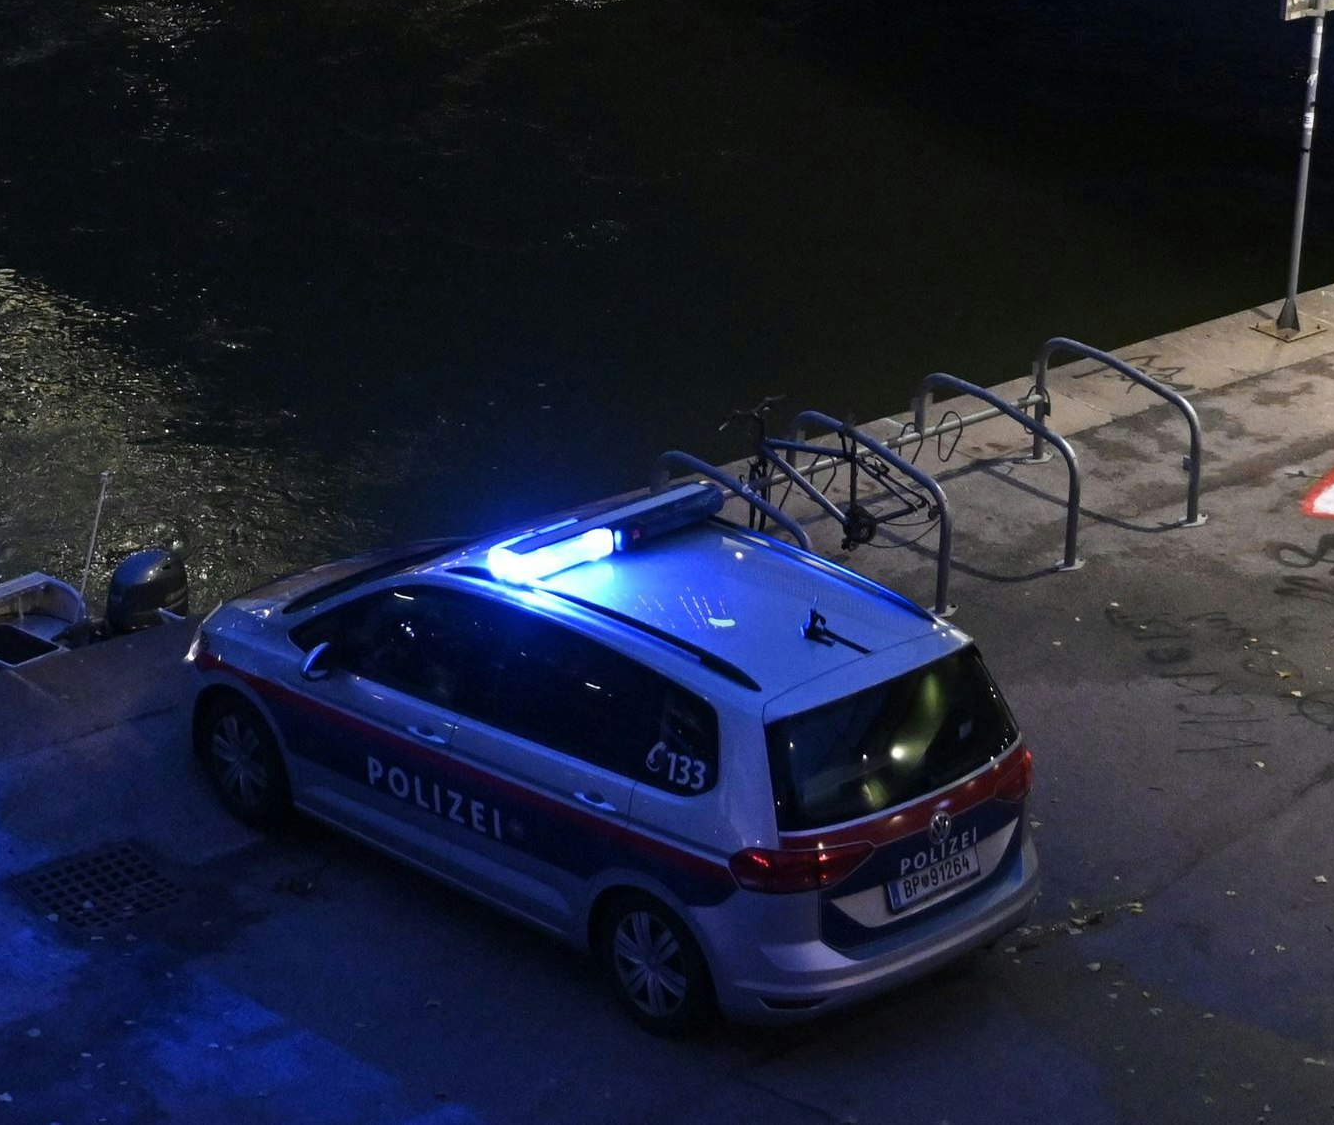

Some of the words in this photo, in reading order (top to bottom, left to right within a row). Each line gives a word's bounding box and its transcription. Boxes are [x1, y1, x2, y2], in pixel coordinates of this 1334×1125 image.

[667, 751, 707, 791] 133
[367, 755, 503, 840] POLIZEI
[899, 824, 978, 876] POLIZEI
